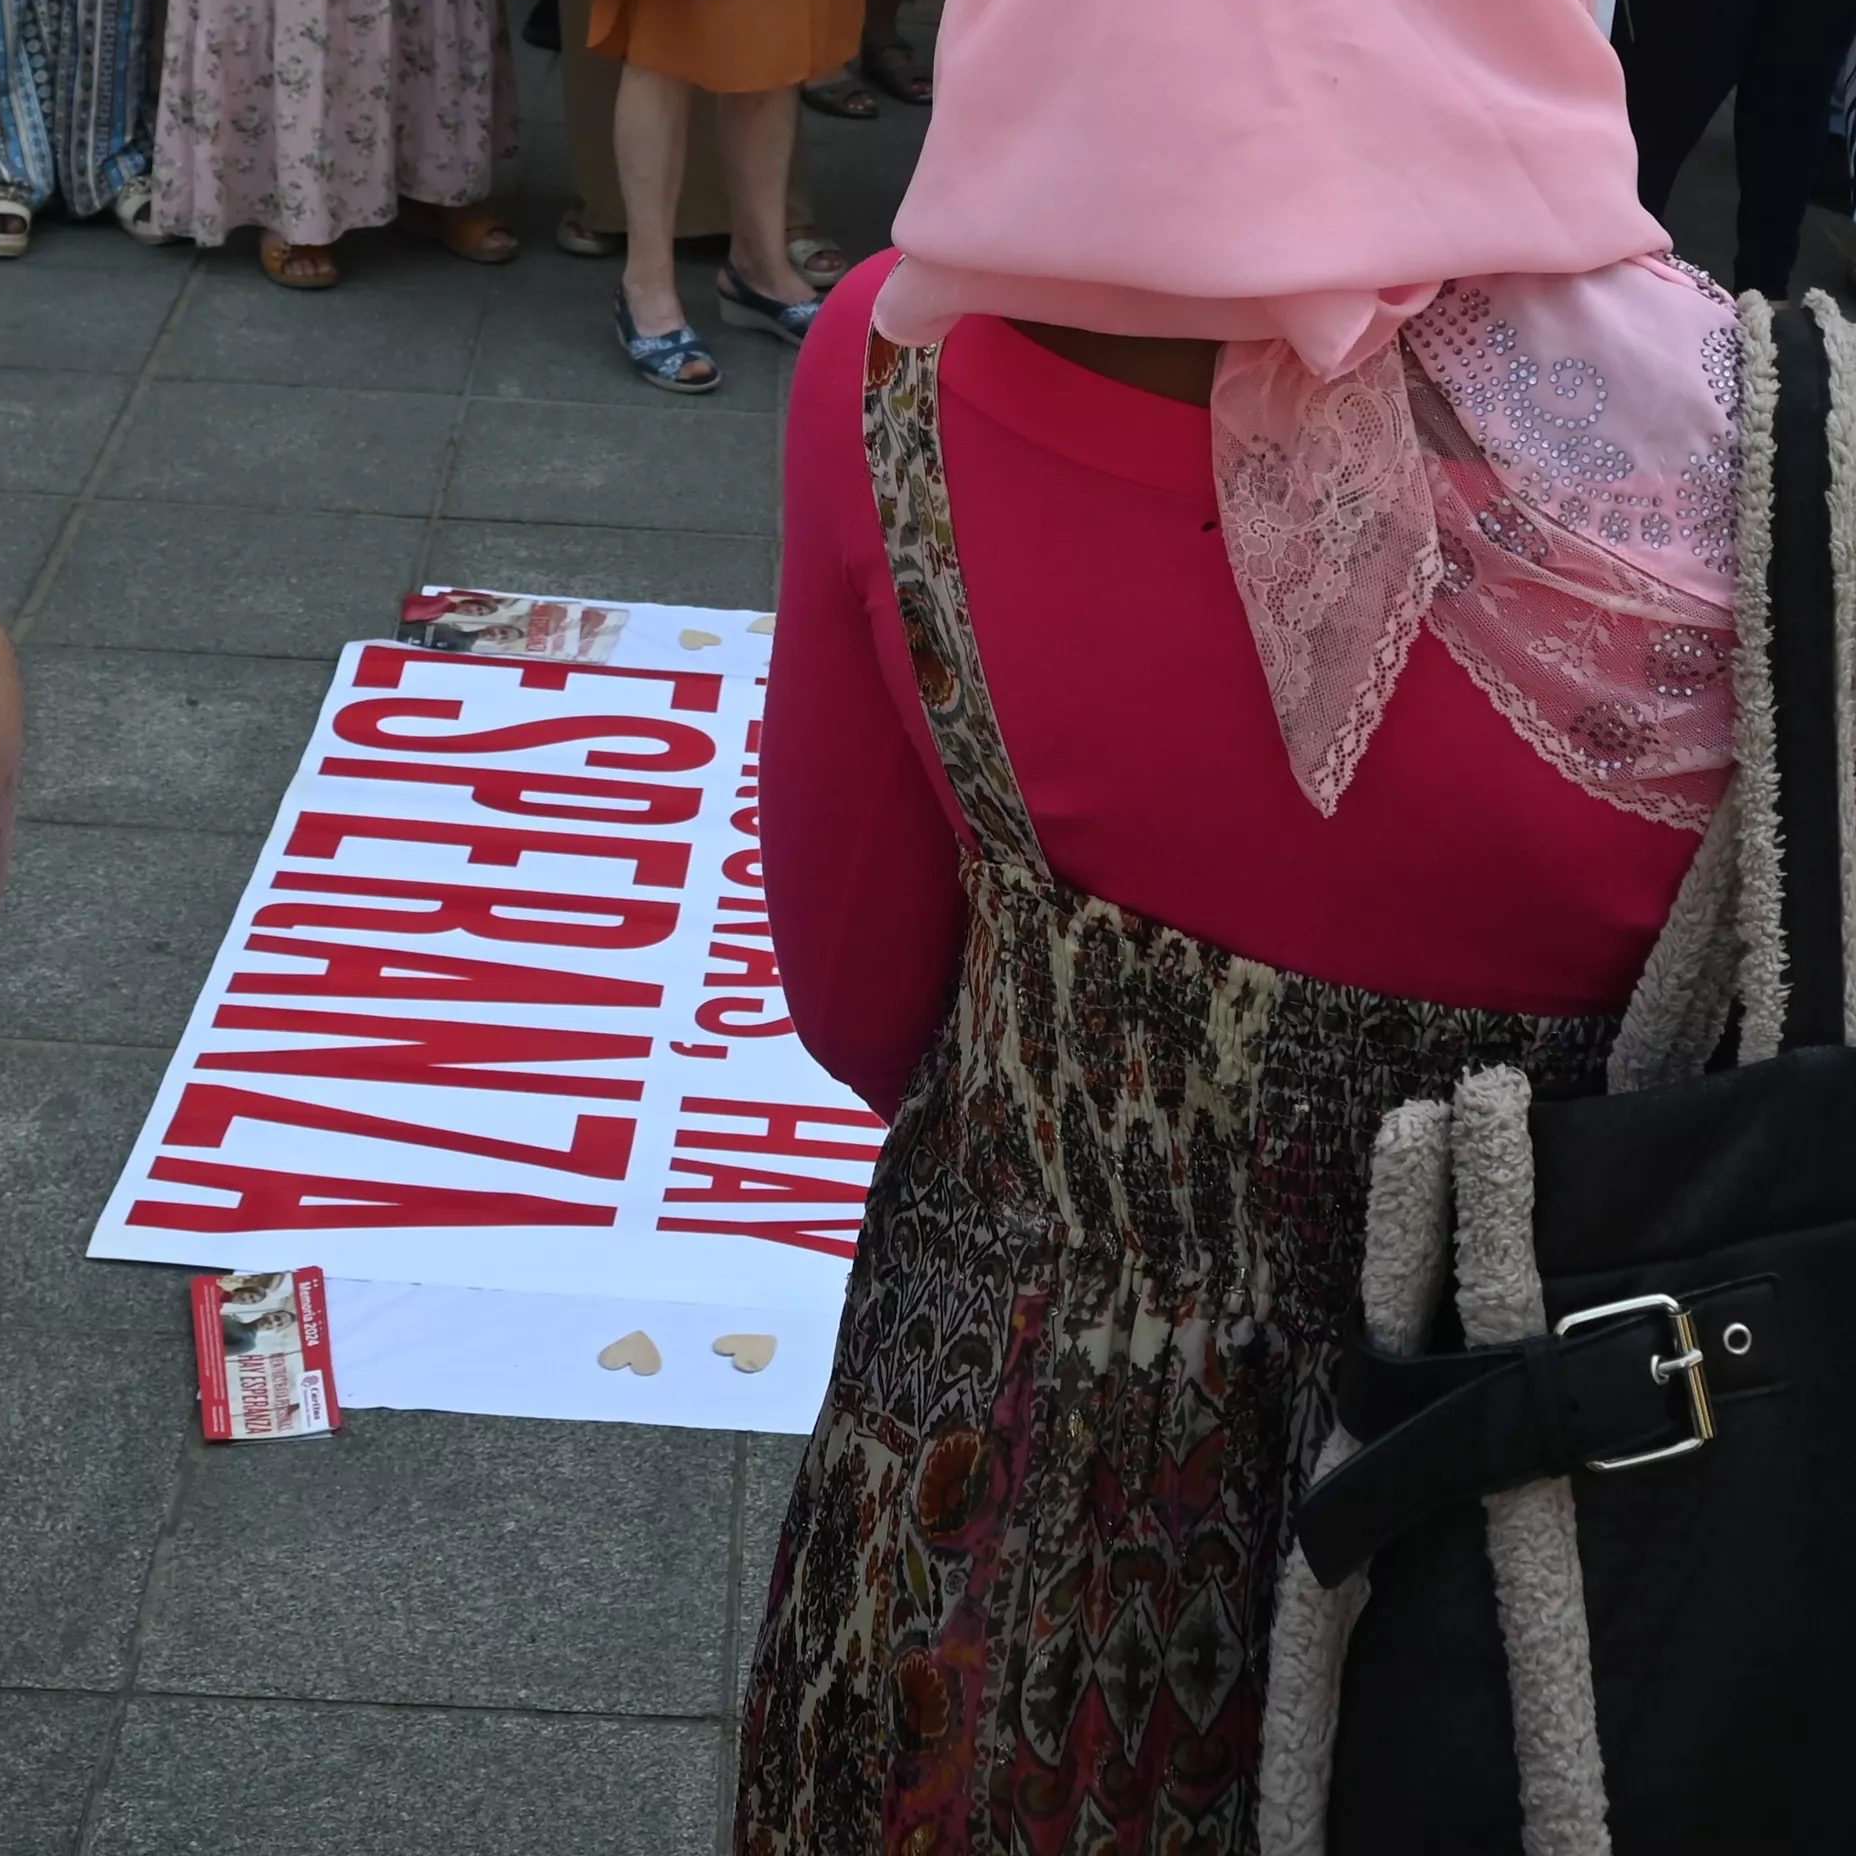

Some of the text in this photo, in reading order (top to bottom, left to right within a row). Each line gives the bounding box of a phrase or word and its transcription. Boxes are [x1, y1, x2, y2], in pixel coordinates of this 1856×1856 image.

[126, 644, 722, 1233] ESPERANZA
[657, 1097, 888, 1261] HAY
[298, 1281, 320, 1347] Memoria 2024
[238, 1354, 273, 1436] HAY ESPERANZA
